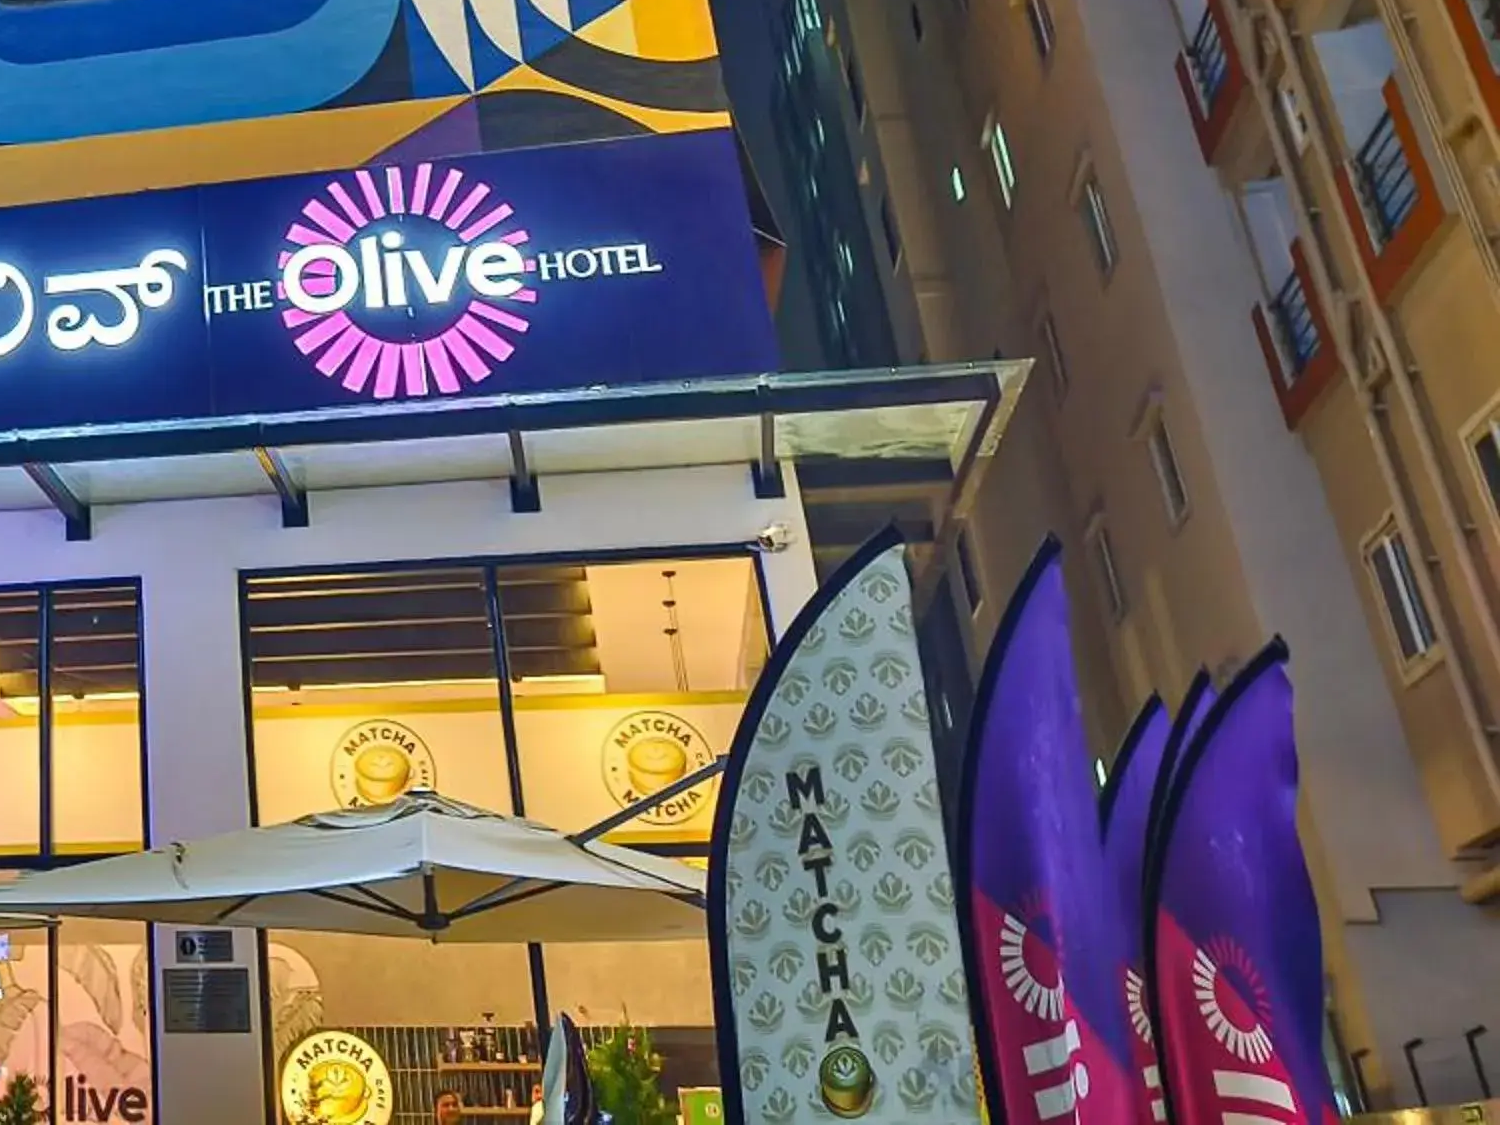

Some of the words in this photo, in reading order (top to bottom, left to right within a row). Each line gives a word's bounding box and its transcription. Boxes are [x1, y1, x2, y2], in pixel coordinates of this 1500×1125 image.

[204, 280, 274, 314] THE
[283, 231, 525, 313] Olive
[539, 243, 662, 281] HOTEL
[343, 728, 416, 756] MATCHA
[613, 718, 691, 747] MATCHA
[623, 789, 702, 817] MTCHA
[785, 767, 859, 1043] MATCHA
[296, 1038, 373, 1073] MATCHA
